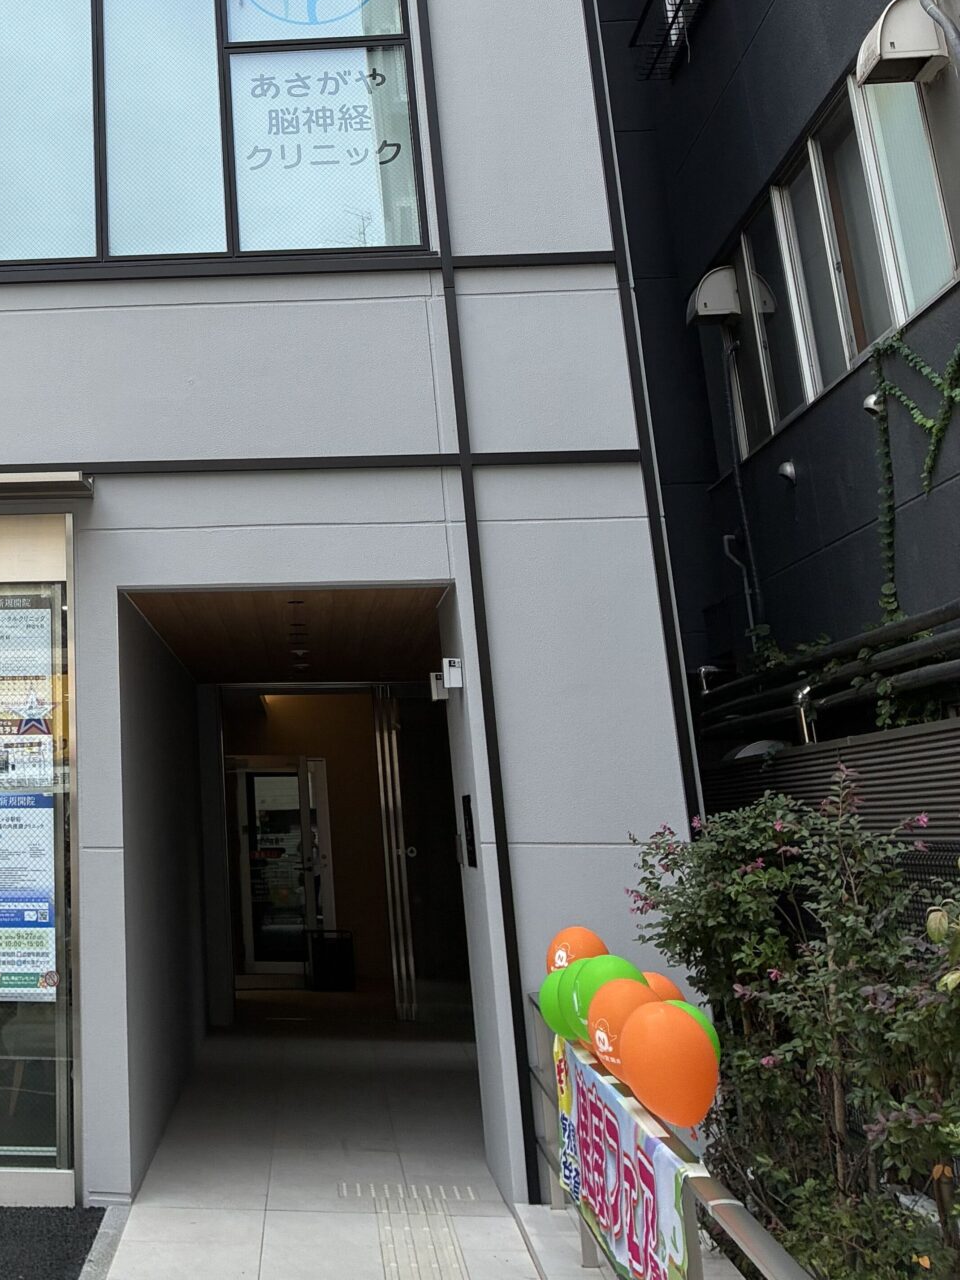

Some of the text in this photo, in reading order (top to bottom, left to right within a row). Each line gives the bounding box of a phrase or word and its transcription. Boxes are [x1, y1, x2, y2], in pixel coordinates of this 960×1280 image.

[250, 67, 386, 100] あさがや
[267, 104, 372, 136] 脳神経
[246, 139, 402, 171] クリニック
[0, 796, 36, 806] 新規開院
